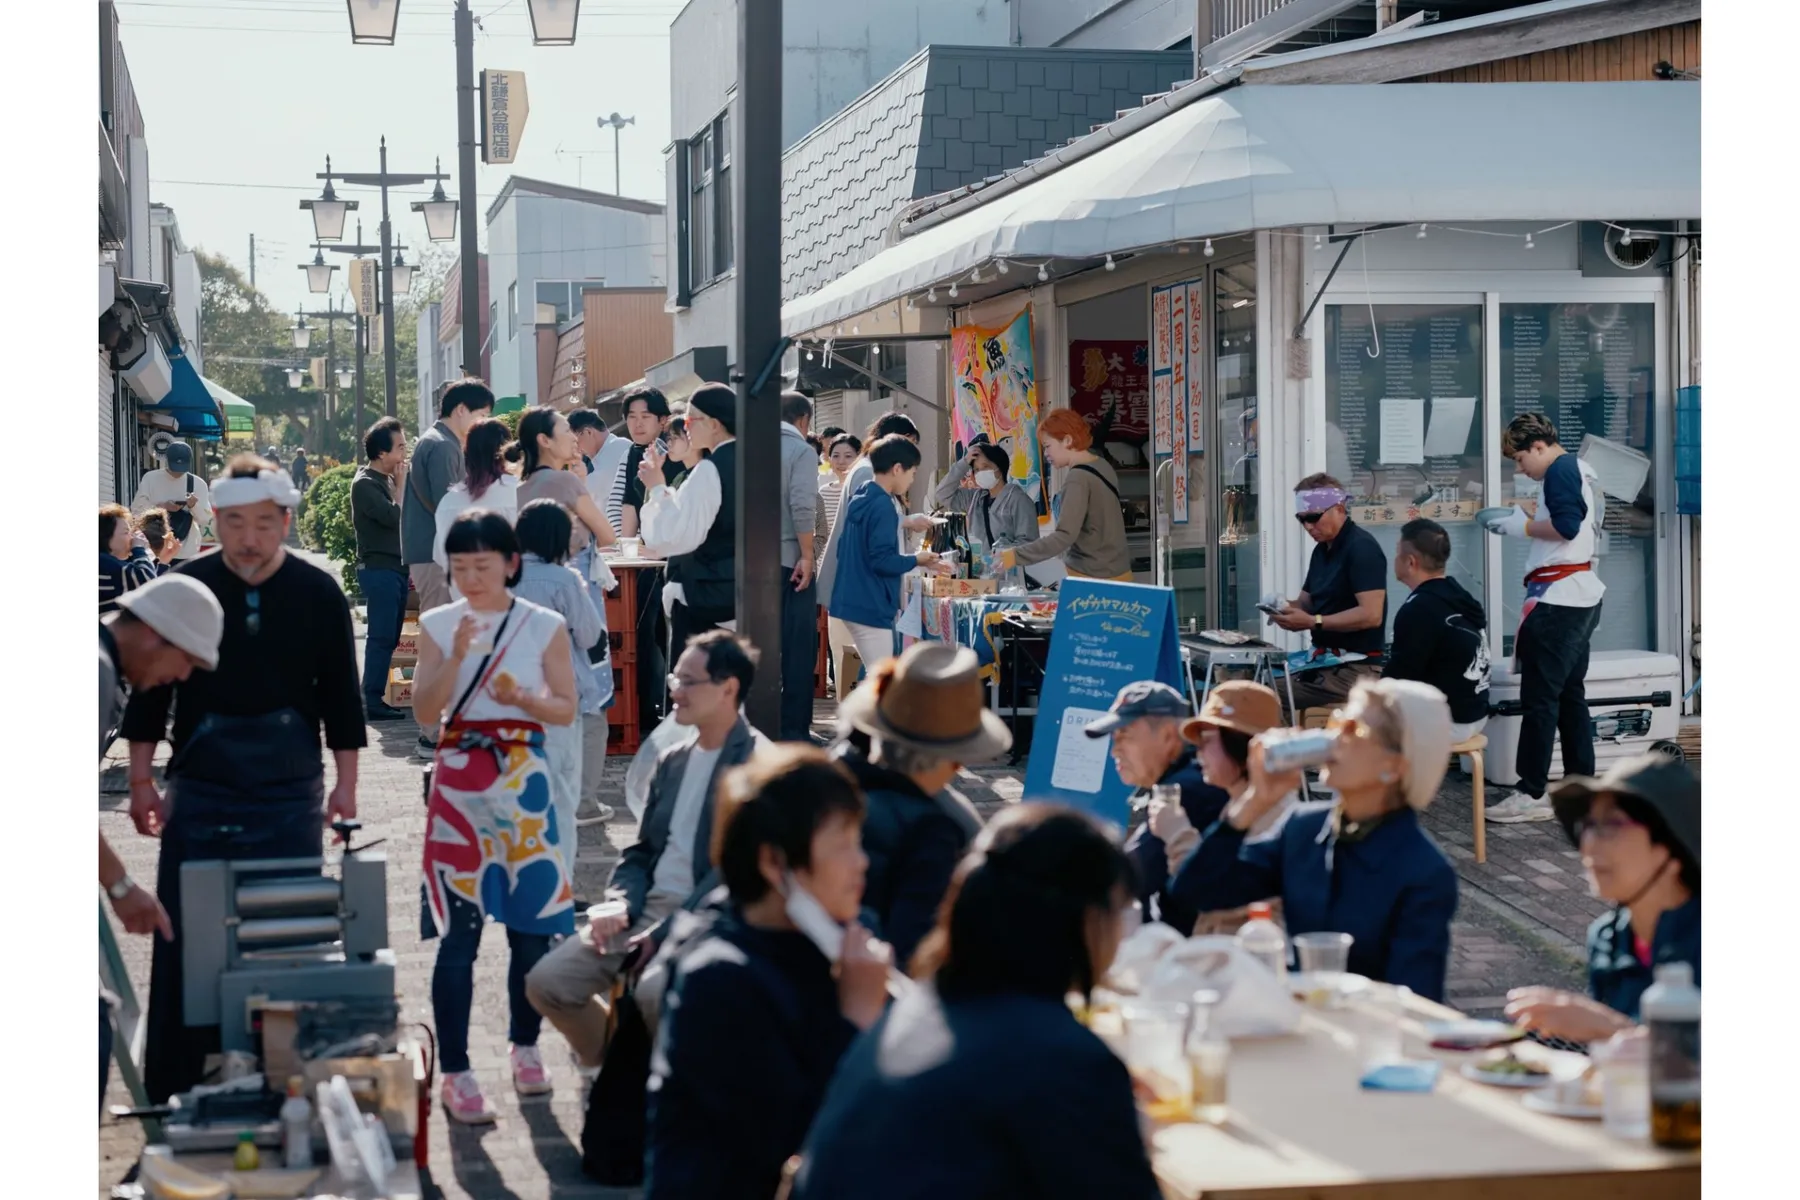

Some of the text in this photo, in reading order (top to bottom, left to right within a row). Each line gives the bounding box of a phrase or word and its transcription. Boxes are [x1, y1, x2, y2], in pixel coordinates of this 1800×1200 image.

[491, 73, 509, 158] 北鎌倉台商店街
[1107, 352, 1126, 372] 大
[1172, 294, 1186, 513] 二周年感謝祭
[1066, 593, 1153, 618] イザカヤマルカマ
